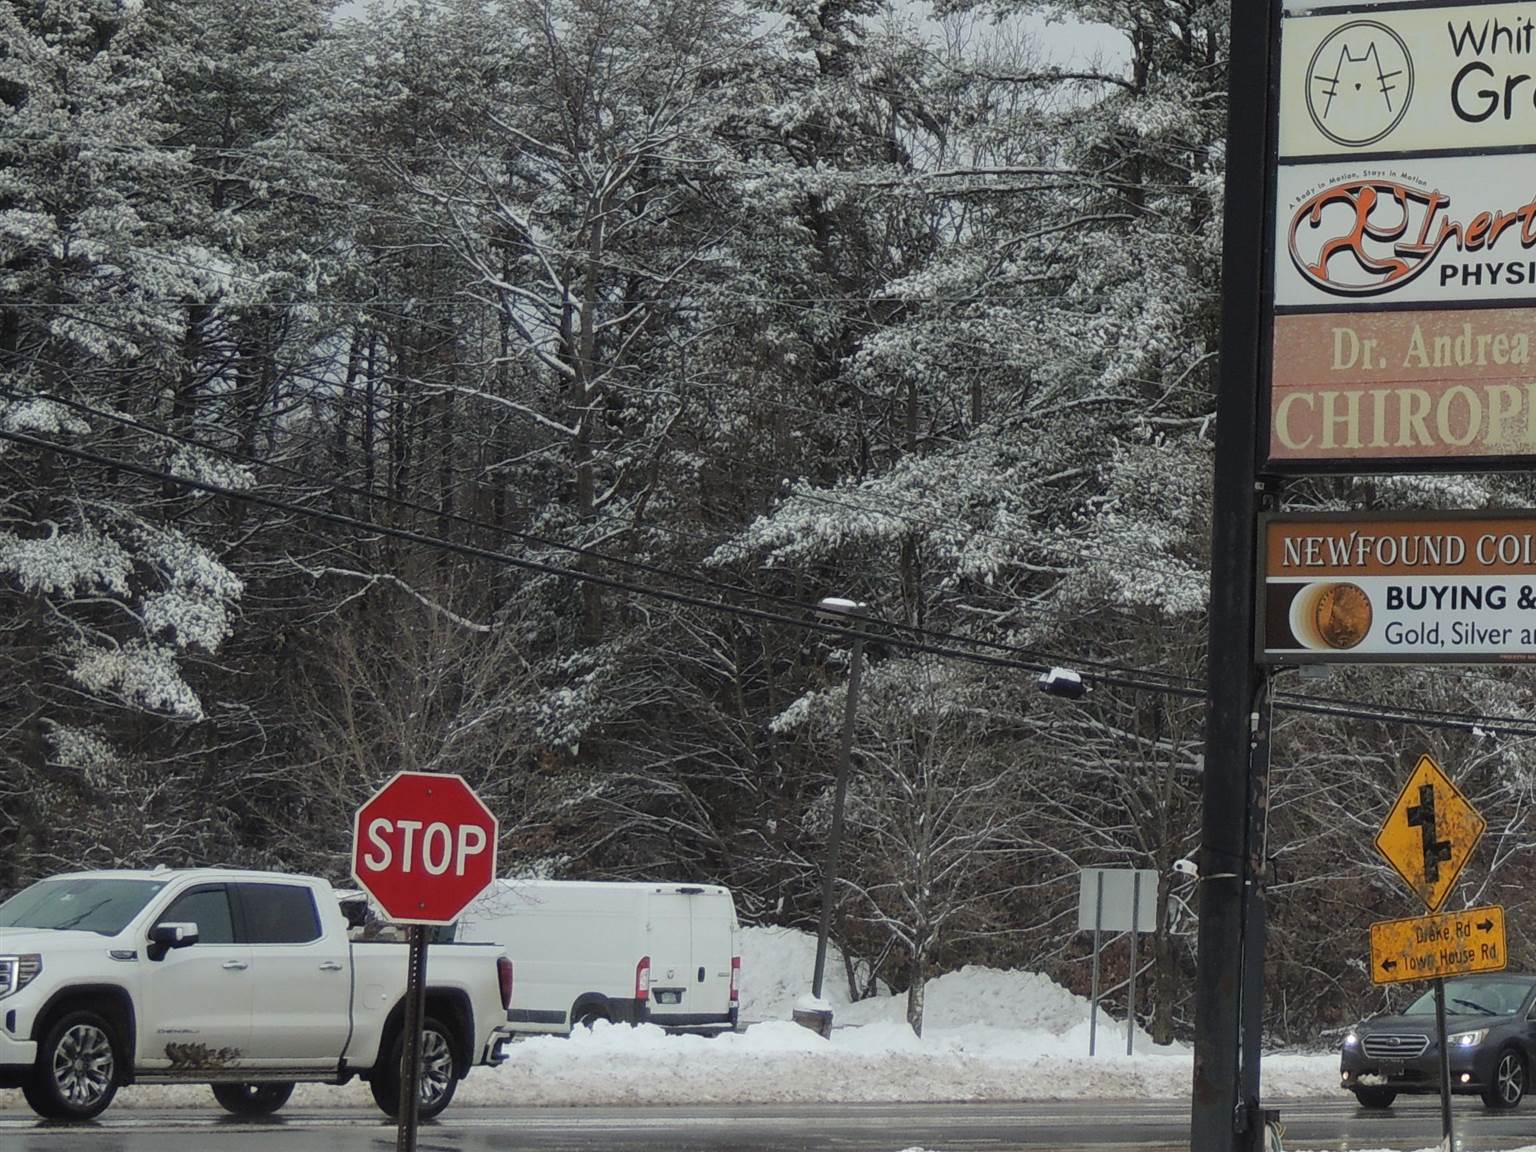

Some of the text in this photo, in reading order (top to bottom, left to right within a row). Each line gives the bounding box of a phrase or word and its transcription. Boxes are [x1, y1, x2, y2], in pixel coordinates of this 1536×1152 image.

[1330, 326, 1386, 371] Dr.
[1403, 324, 1529, 368] Andrea
[1281, 530, 1465, 567] NEWFOUND
[1386, 585, 1507, 611] BUYING
[1385, 622, 1446, 649] Gold,
[1451, 621, 1513, 646] Silver
[364, 817, 487, 876] STOP
[1416, 921, 1471, 944] Drake Rd
[1440, 949, 1475, 966] House
[1480, 943, 1497, 960] Rd
